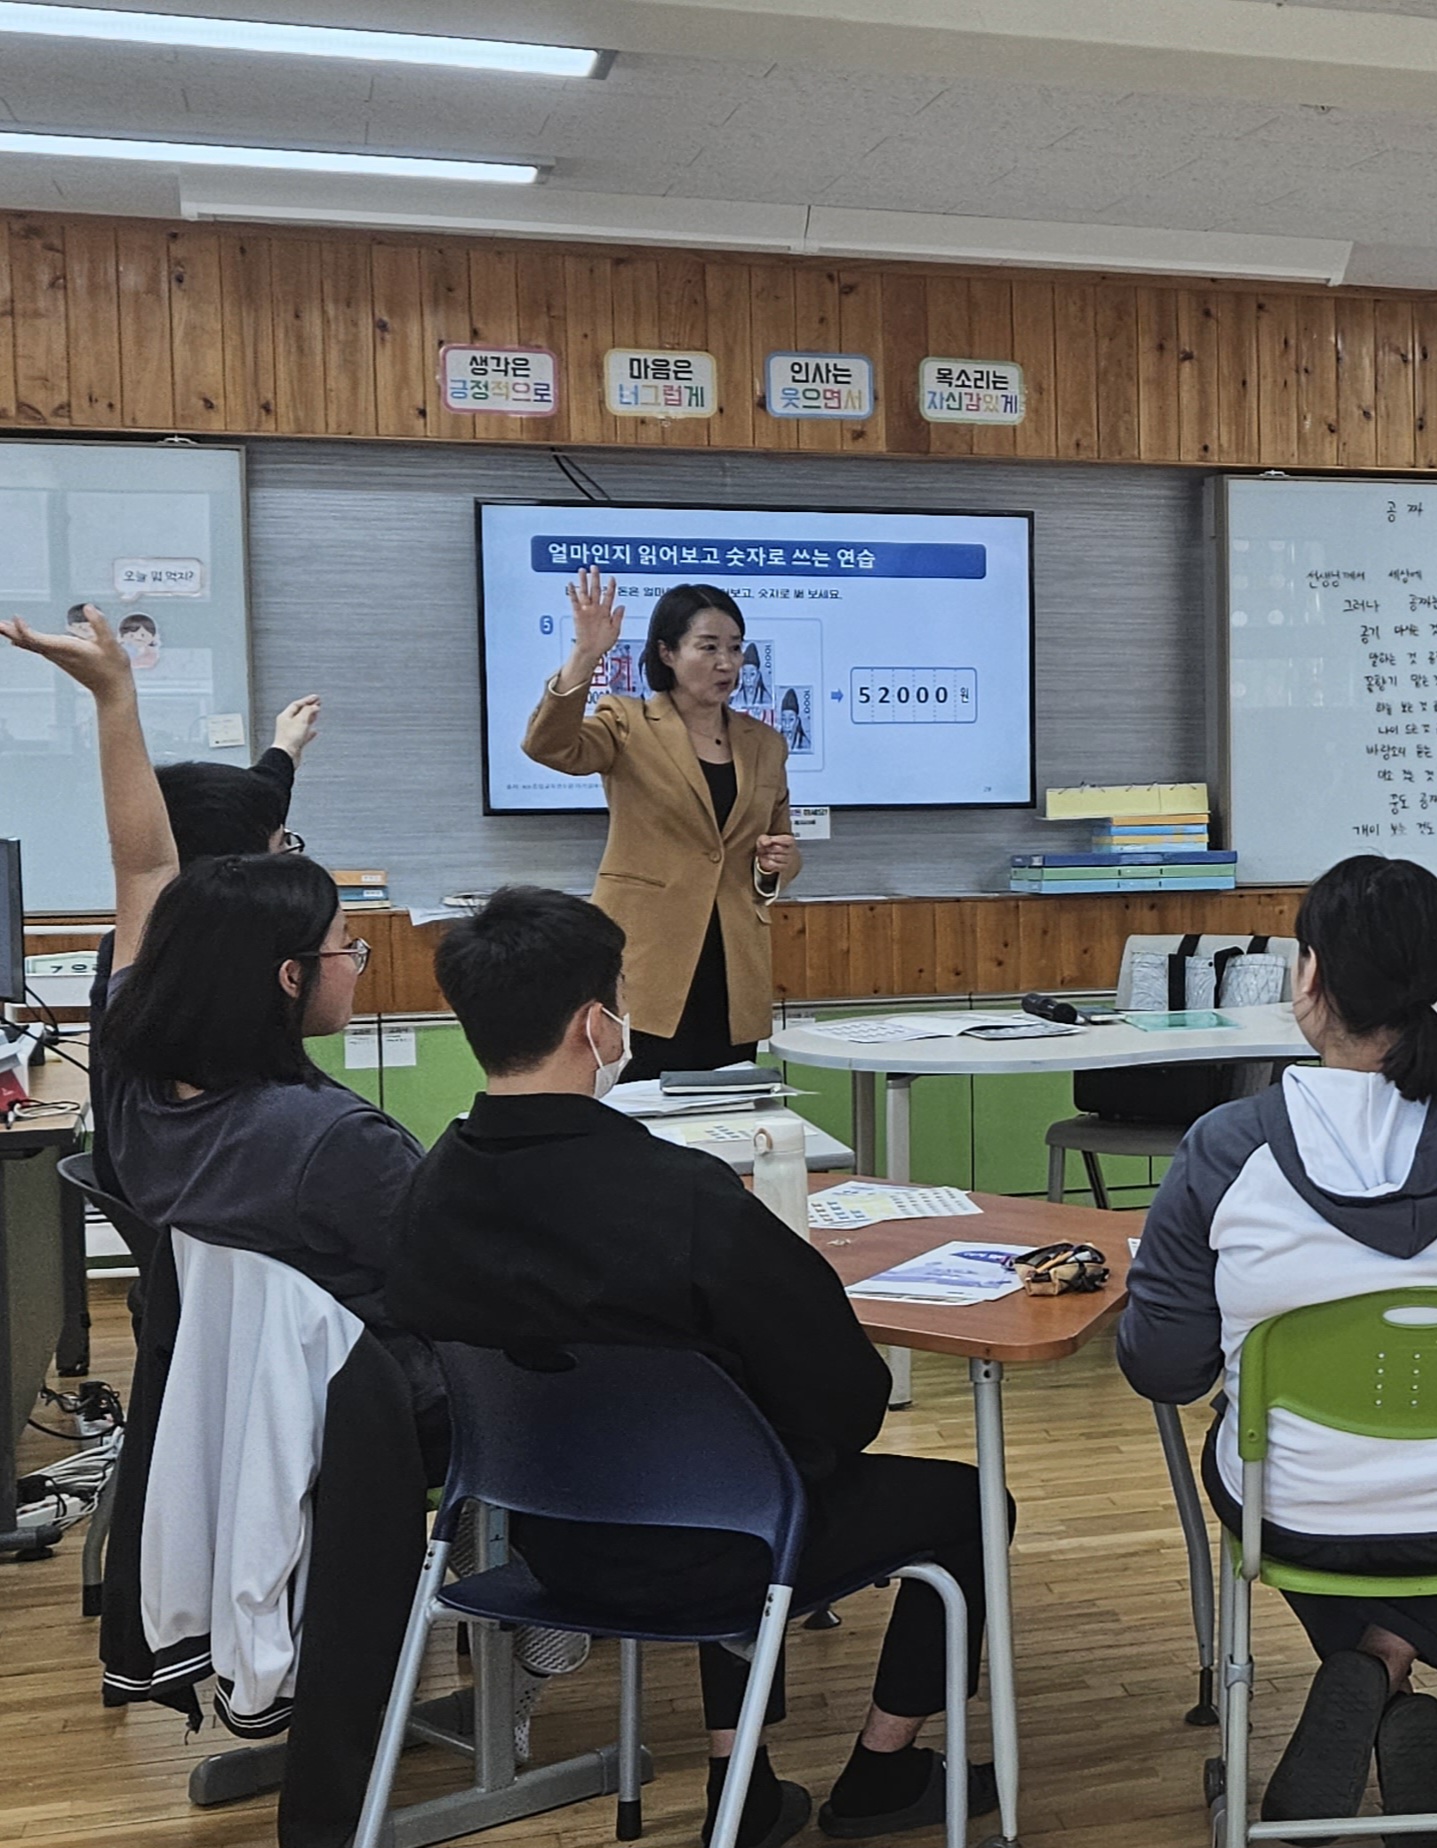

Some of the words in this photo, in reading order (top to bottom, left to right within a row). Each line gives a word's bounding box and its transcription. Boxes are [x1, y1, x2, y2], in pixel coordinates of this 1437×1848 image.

[469, 355, 531, 378] 생각은
[629, 357, 693, 381] 마음은
[790, 361, 852, 385] 인사는
[935, 367, 1009, 391] 목소리는
[449, 379, 552, 403] 긍정적으로
[618, 383, 704, 408] 너그럽게
[780, 387, 862, 410] 웃으면서
[927, 391, 1018, 414] 자신감있게
[548, 542, 631, 565] 얼마인지
[638, 544, 720, 566] 읽어보고
[725, 546, 786, 567] 숫자로
[791, 549, 831, 568] 쓰는
[837, 548, 876, 569] 연습
[123, 570, 147, 583] 오늘
[617, 585, 640, 597] 돈은
[758, 588, 790, 599] 숫자로
[1343, 599, 1380, 613] 그러나
[1360, 625, 1380, 645] 공기
[1407, 652, 1417, 665] 것
[960, 687, 970, 704] 원
[1419, 701, 1428, 712] 것
[1425, 770, 1434, 781] 것
